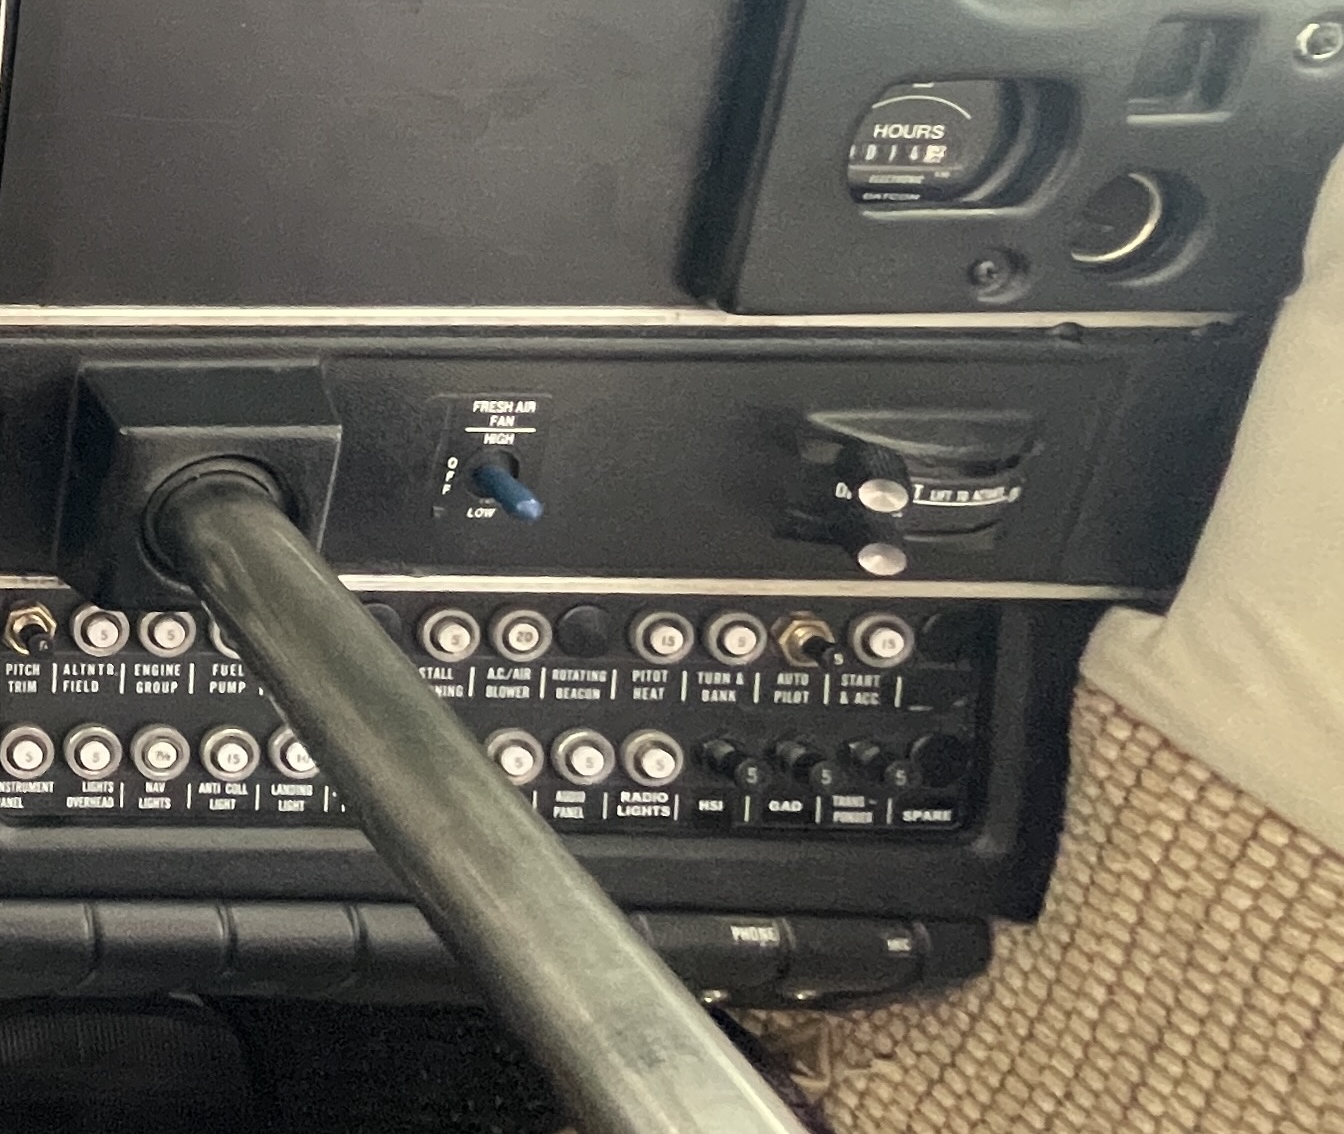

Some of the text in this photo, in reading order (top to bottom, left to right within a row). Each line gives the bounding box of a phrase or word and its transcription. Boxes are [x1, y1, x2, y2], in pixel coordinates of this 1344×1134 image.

[873, 124, 946, 140] HOURS
[489, 415, 515, 427] FAN
[483, 433, 515, 445] HIGH
[466, 507, 497, 518] LOW
[5, 663, 40, 676] PITCH
[134, 664, 181, 677] ENGINE
[212, 664, 244, 677] FUEL
[631, 670, 668, 682] PITOT
[8, 680, 37, 693] TRIM
[63, 680, 99, 693] FIELD
[135, 681, 179, 694] GROUP
[209, 681, 246, 694] PUMP
[555, 688, 601, 700] BEACON
[632, 688, 665, 700] HEAT
[138, 797, 172, 810] LIGHTS
